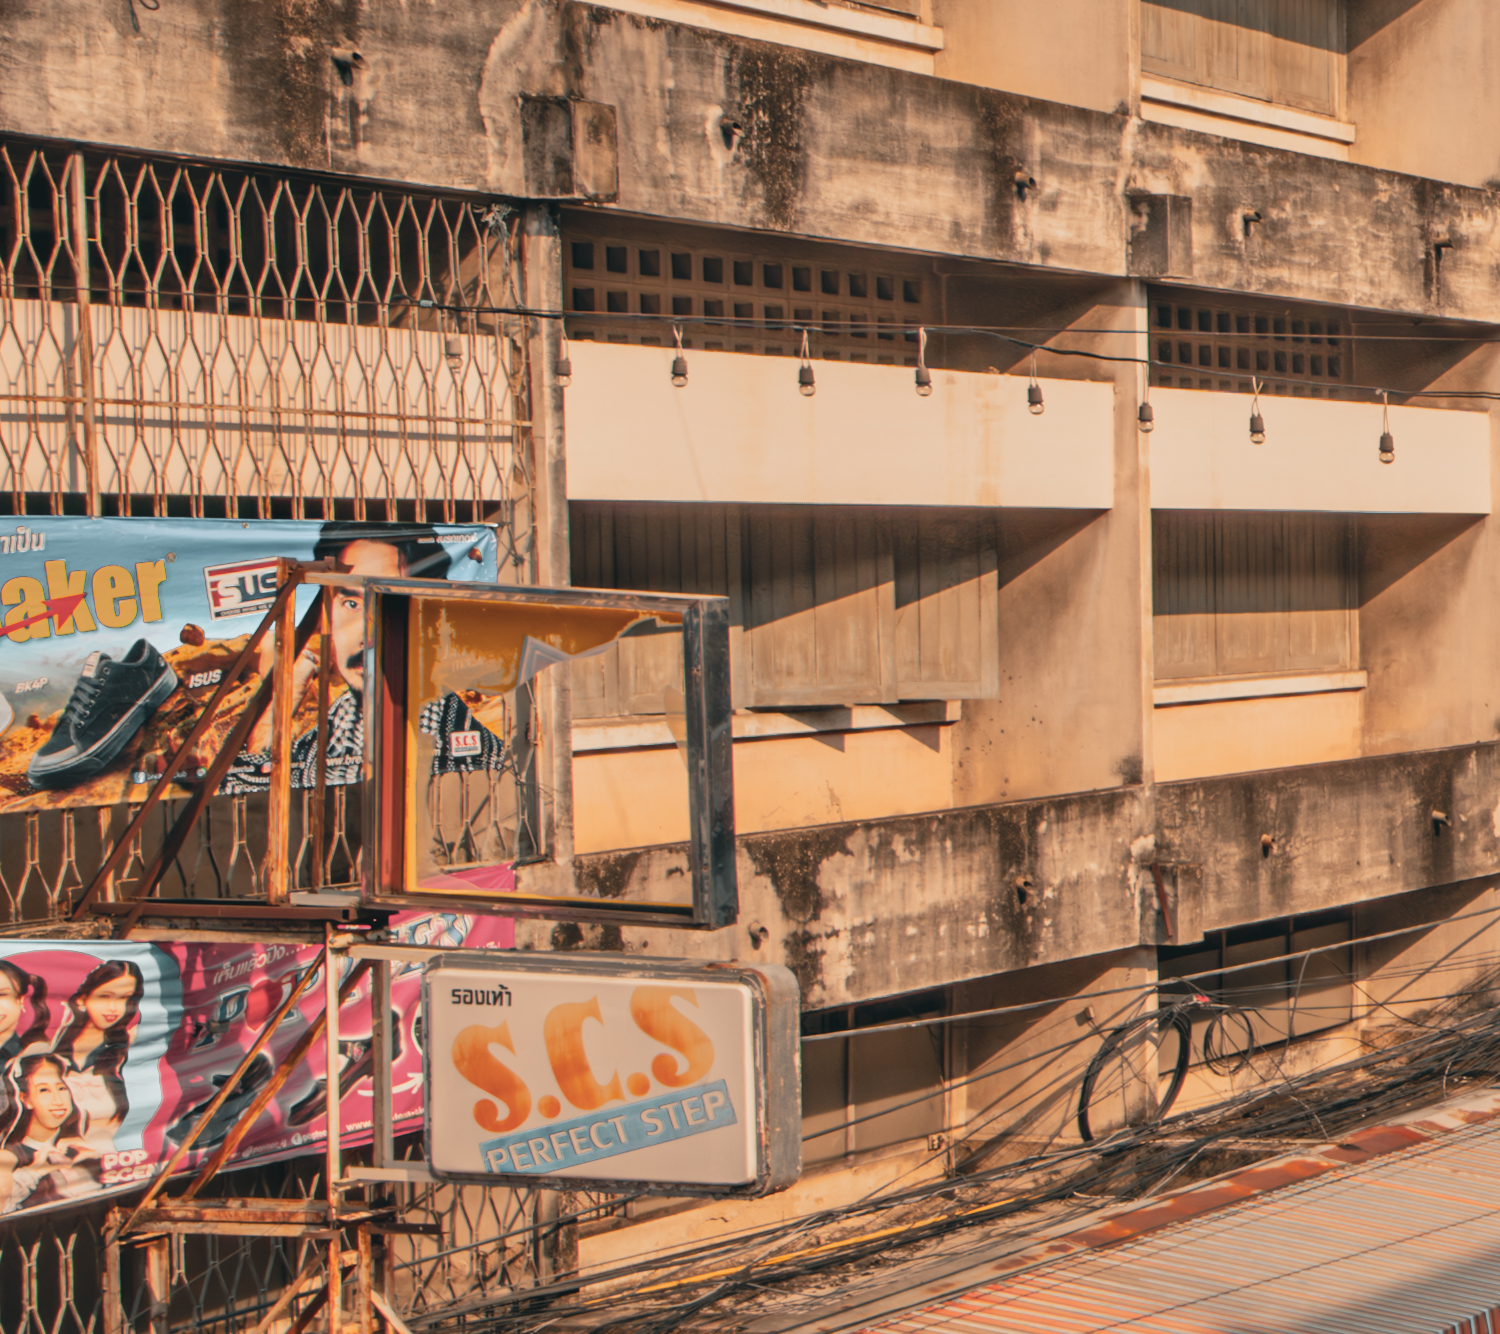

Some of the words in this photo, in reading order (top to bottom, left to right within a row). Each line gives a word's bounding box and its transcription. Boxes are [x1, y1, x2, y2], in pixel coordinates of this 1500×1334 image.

[188, 669, 222, 689] ISUS
[451, 983, 512, 1007] รองเท้า
[452, 984, 715, 1134] S.C.S
[485, 1115, 630, 1174] PERFECT
[639, 1089, 728, 1137] STEP
[104, 1150, 149, 1170] POP
[104, 1161, 172, 1183] SCEN
